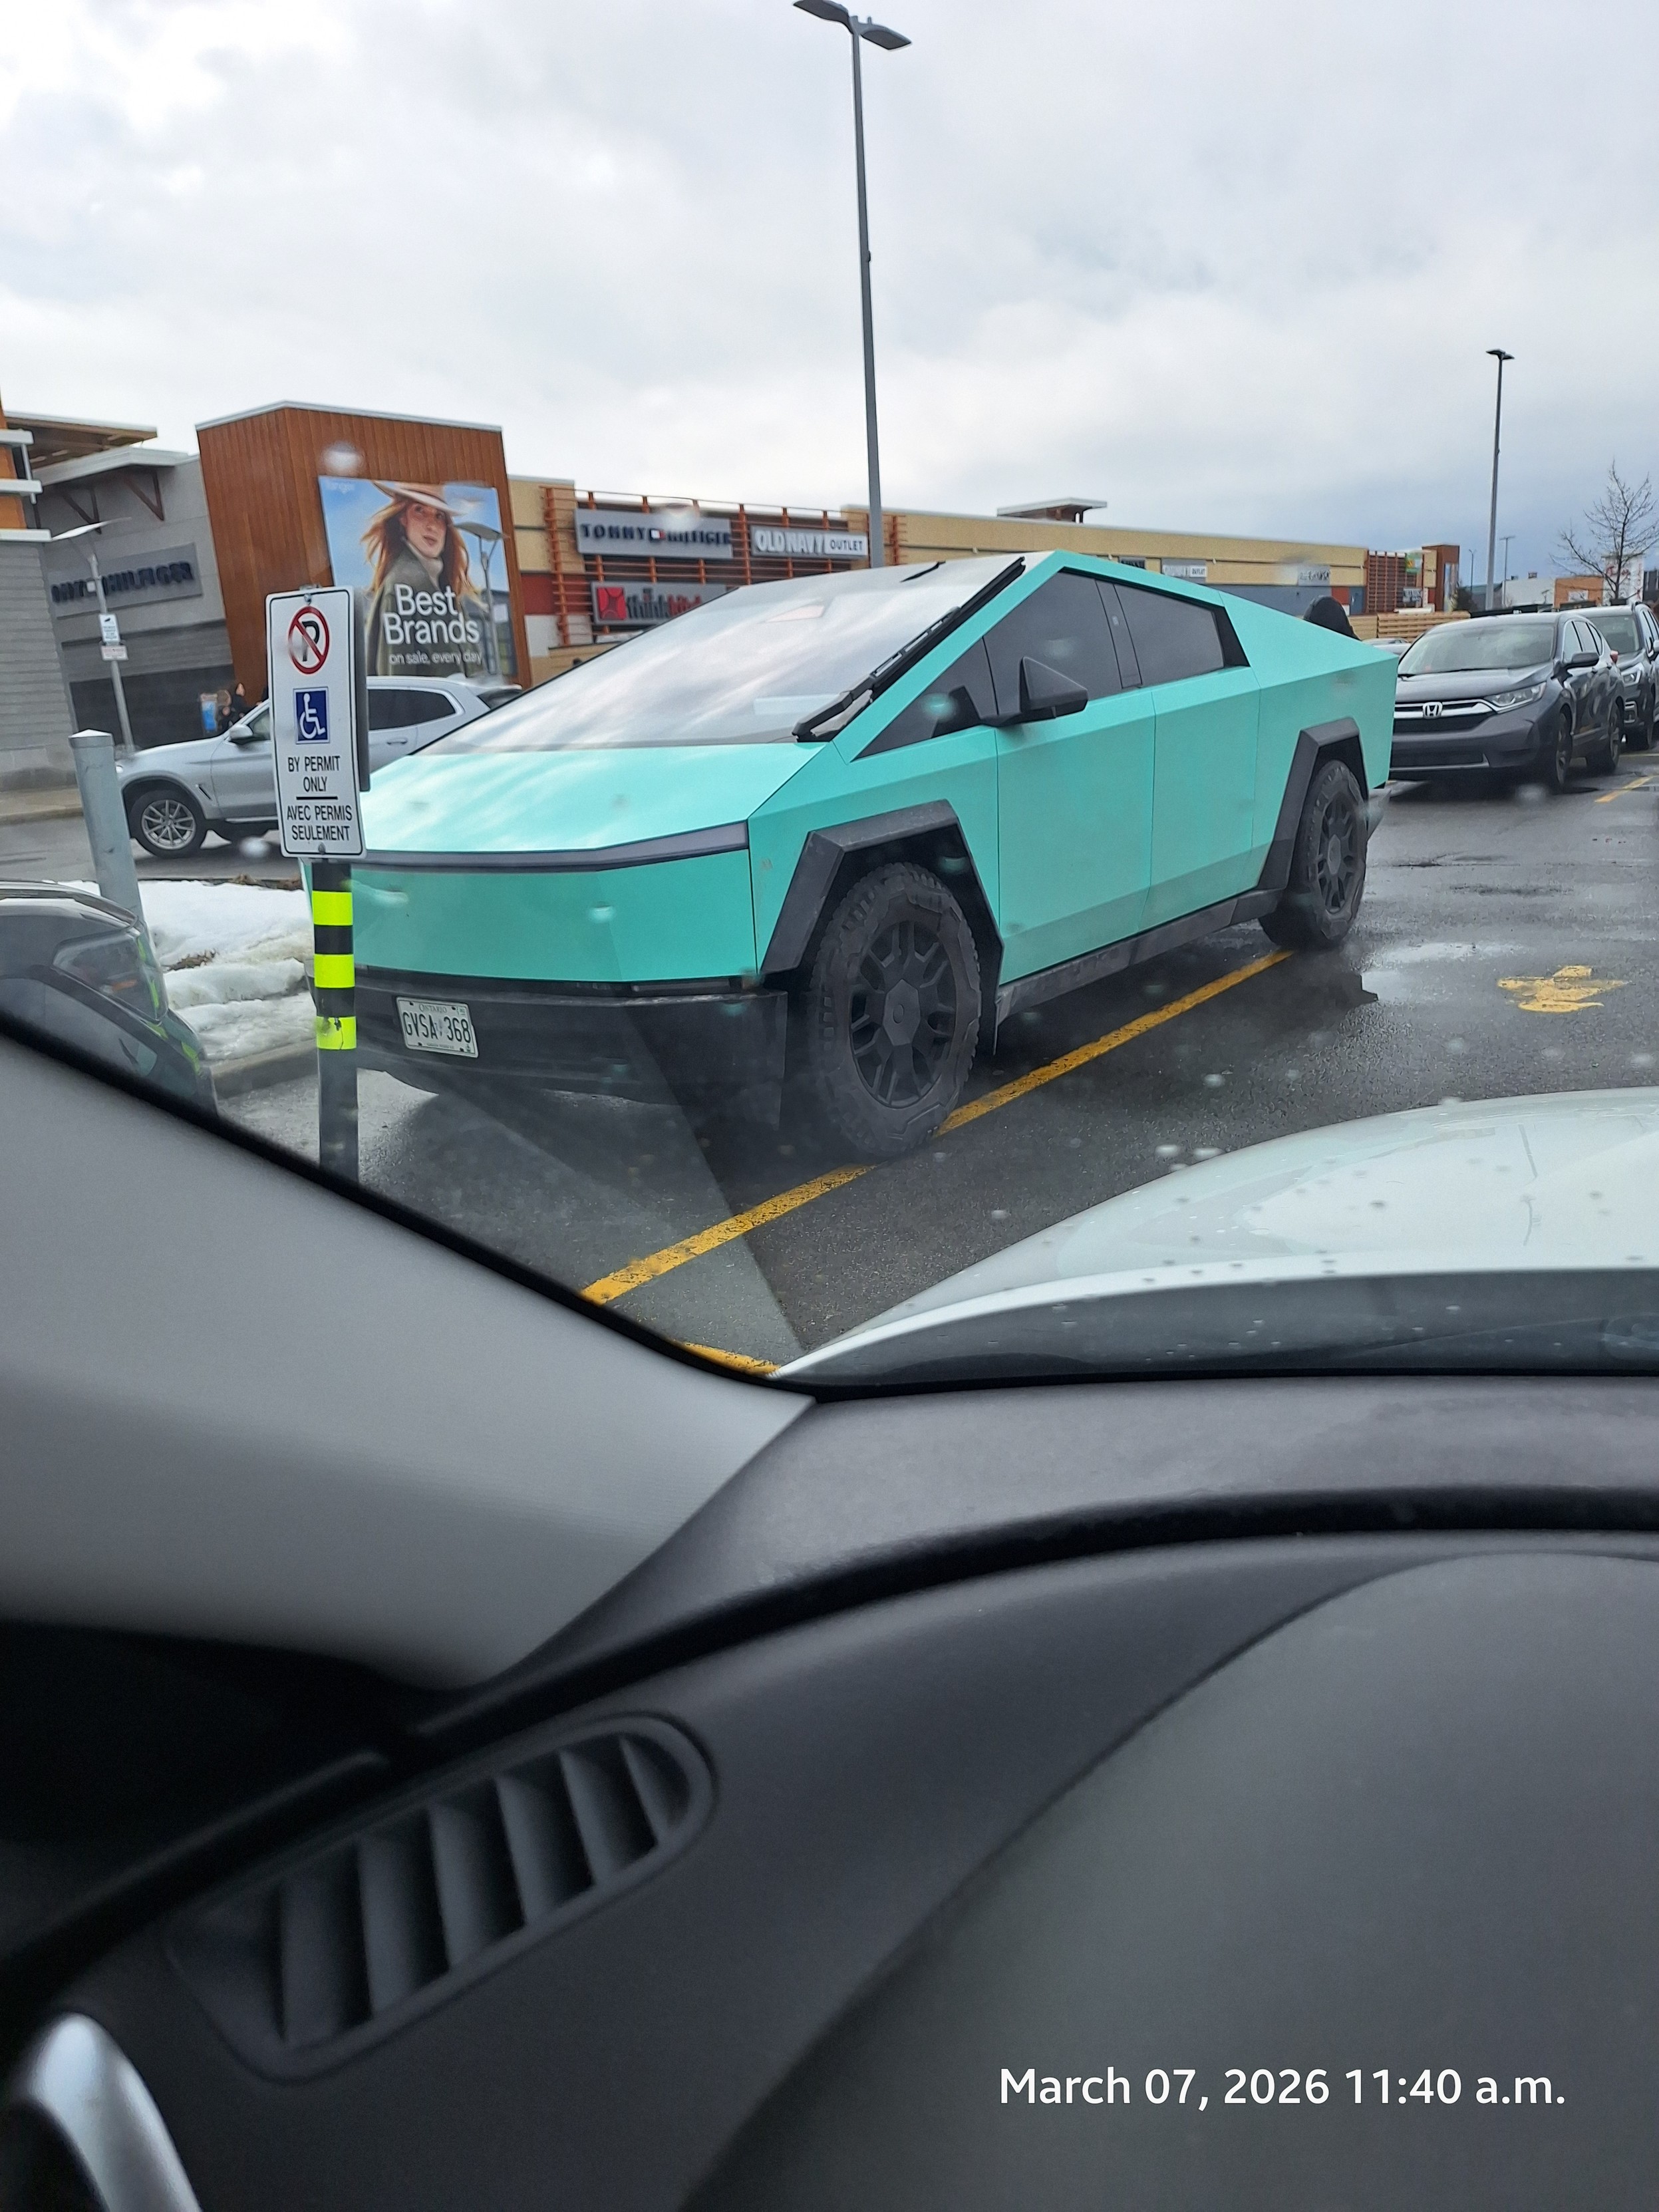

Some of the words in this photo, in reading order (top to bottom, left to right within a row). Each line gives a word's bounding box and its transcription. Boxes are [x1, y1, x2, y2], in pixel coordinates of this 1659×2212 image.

[581, 524, 645, 540] TOMMY
[755, 530, 786, 552] OLD
[785, 532, 824, 554] NAVY
[831, 539, 863, 551] OUTLET
[394, 583, 458, 617] Best
[383, 611, 480, 645] Brands
[389, 653, 405, 665] on
[432, 653, 461, 665] every
[462, 649, 482, 665] day
[287, 757, 299, 772] BY
[305, 755, 341, 772] PERMIT
[303, 776, 327, 792] ONLY
[287, 805, 311, 821] AVEC
[315, 805, 353, 821] PERMIS
[291, 825, 350, 841] SEULEMENT
[402, 1012, 439, 1040] GVSA
[444, 1016, 471, 1044] 368
